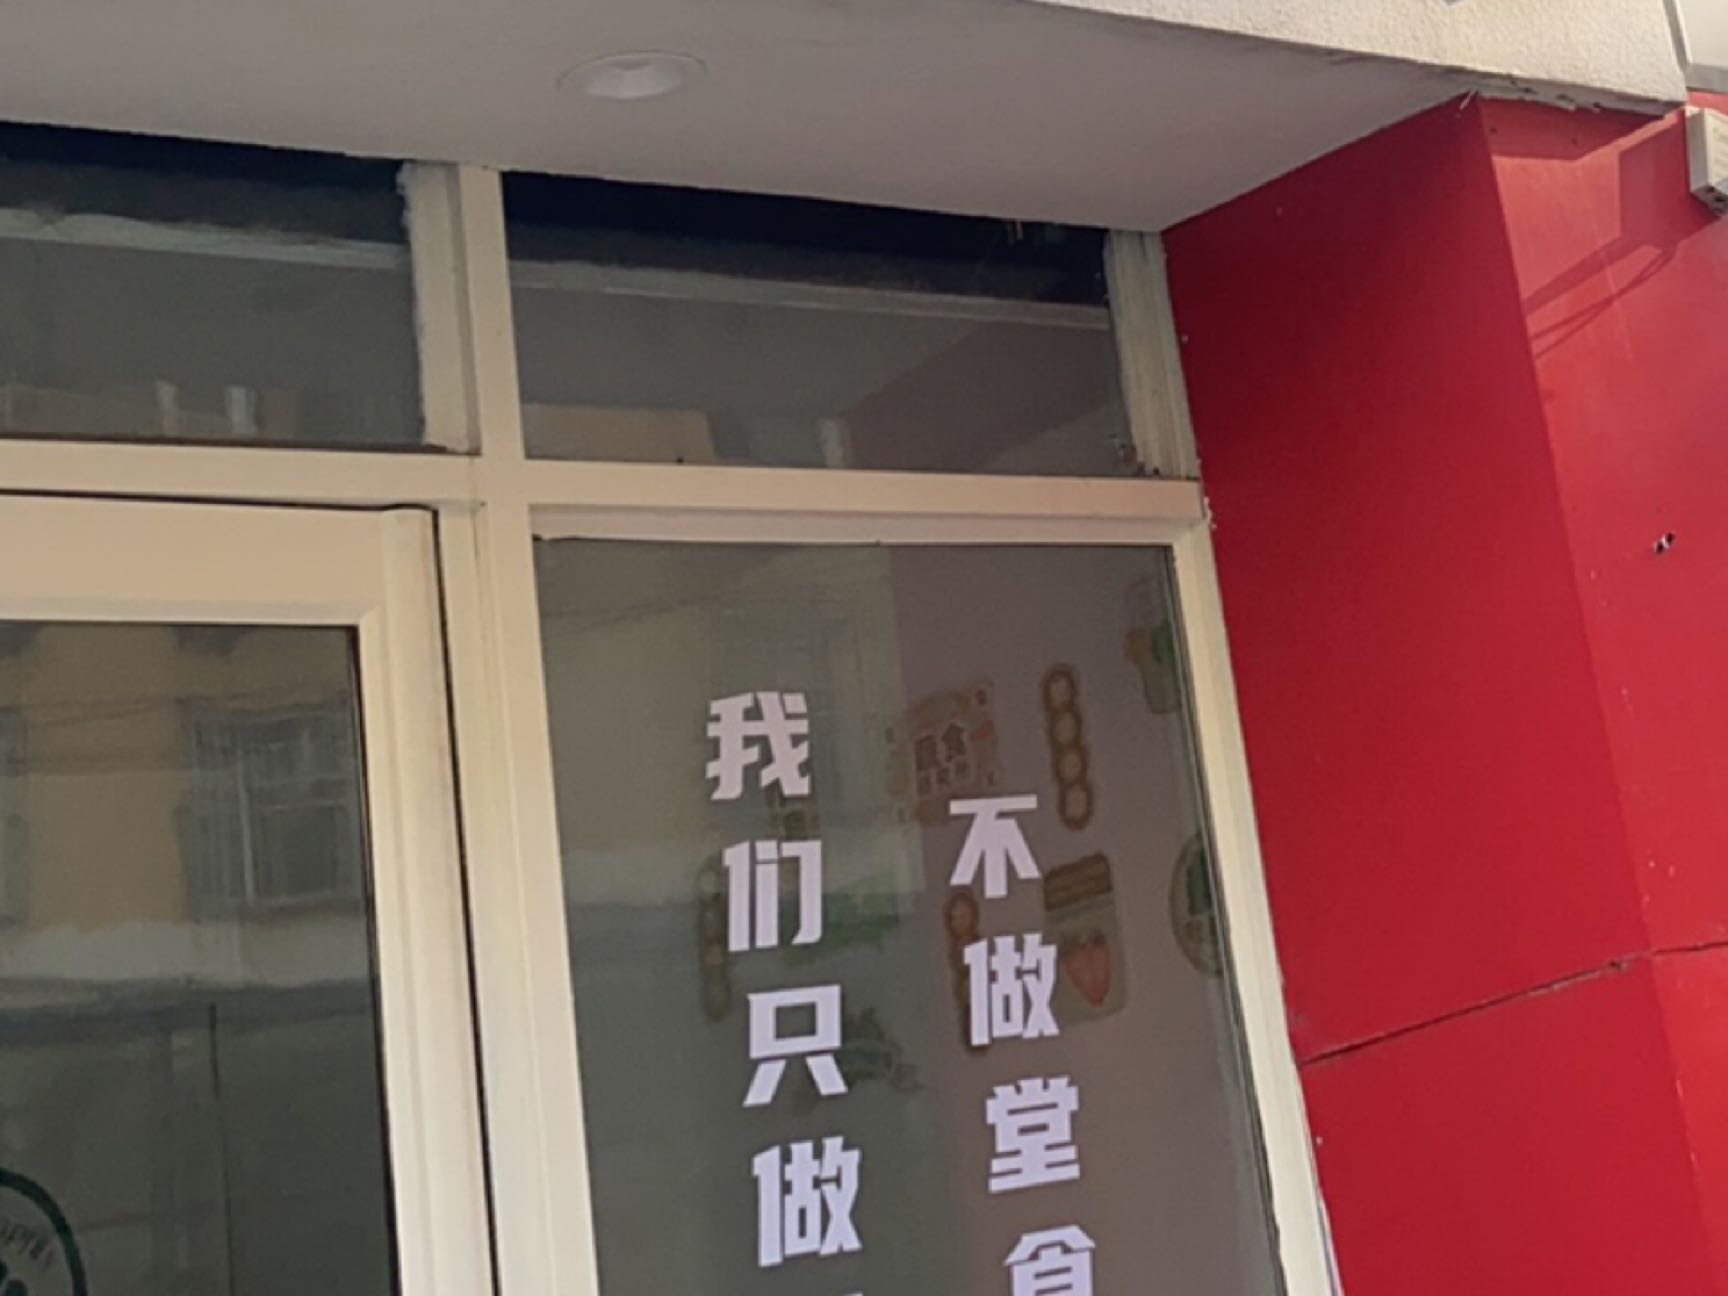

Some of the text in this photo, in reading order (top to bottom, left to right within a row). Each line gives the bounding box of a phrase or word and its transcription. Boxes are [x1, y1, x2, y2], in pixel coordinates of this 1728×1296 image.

[706, 690, 863, 1267] 我们只做
[949, 794, 1097, 1296] 不做堂食
